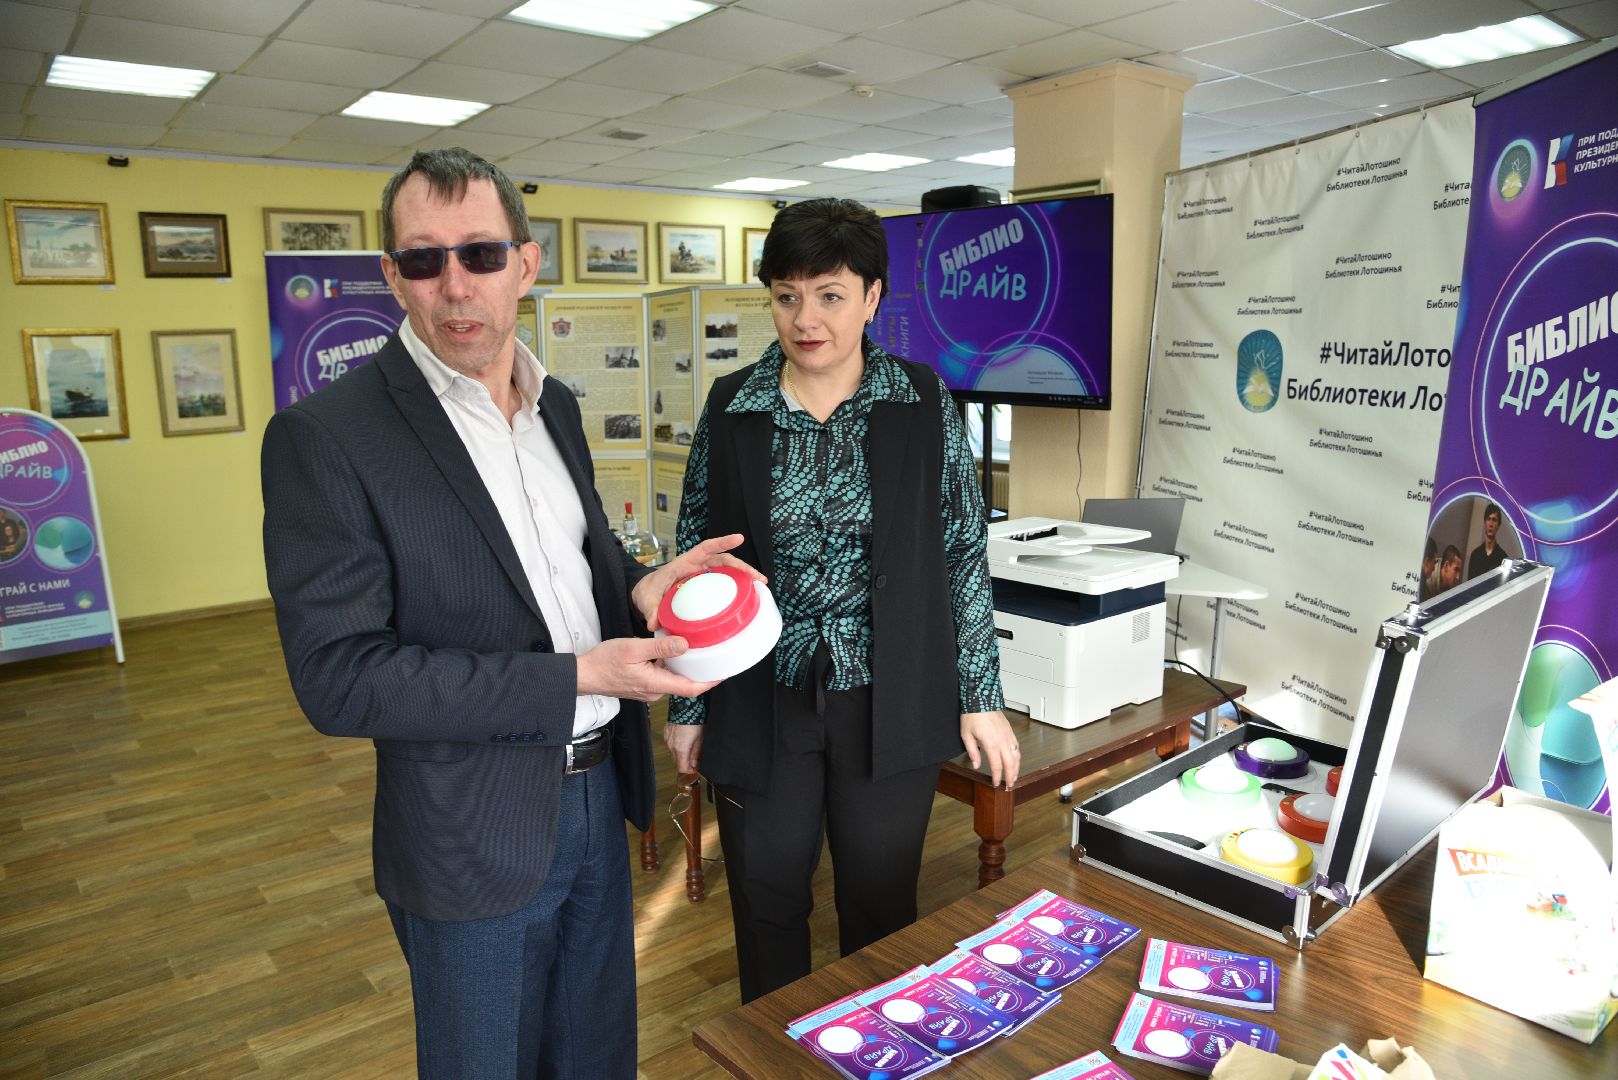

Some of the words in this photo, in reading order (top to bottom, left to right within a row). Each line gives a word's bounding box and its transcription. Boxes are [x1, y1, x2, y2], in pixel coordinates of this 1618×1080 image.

[1578, 135, 1595, 147] ПРИ
[1598, 128, 1618, 141] ПОД
[1337, 158, 1400, 176] #ЧитайЛотошино
[1326, 178, 1370, 192] Библиотеки
[1371, 169, 1407, 184] Лотошинья
[1444, 181, 1472, 192] #Чита
[939, 218, 1024, 275] БИБЛИО
[1336, 252, 1392, 264] #ЧитайЛотошино
[940, 265, 1026, 300] ДРАЙВ
[1326, 269, 1359, 278] Библиотеки
[1360, 266, 1402, 275] Лотошинья
[1320, 341, 1451, 367] #ЧитайЛото
[1287, 378, 1406, 408] Библиотеки
[1410, 386, 1447, 411] Ло
[1499, 363, 1618, 439] ДРАЙВ
[1319, 429, 1373, 442] #ЧитайЛотошино
[1309, 439, 1345, 451] Библиотеки
[1347, 445, 1382, 458] Лотошинья
[0, 462, 52, 479] РАЙВ
[1309, 511, 1364, 531] #ЧитайЛотошино
[1298, 521, 1335, 535] Библиотеки
[1336, 531, 1373, 546] Лотошинья
[29, 583, 36, 592] С
[38, 579, 70, 591] НАМИ
[1295, 592, 1350, 617] #ЧитайЛотошино
[1285, 601, 1320, 619] Библиотеки
[1320, 614, 1357, 634] Лотошинья
[1292, 674, 1347, 705] #ЧитайЛотошино
[1281, 682, 1319, 704] Библиотеки
[1318, 699, 1354, 722] Лотошинья
